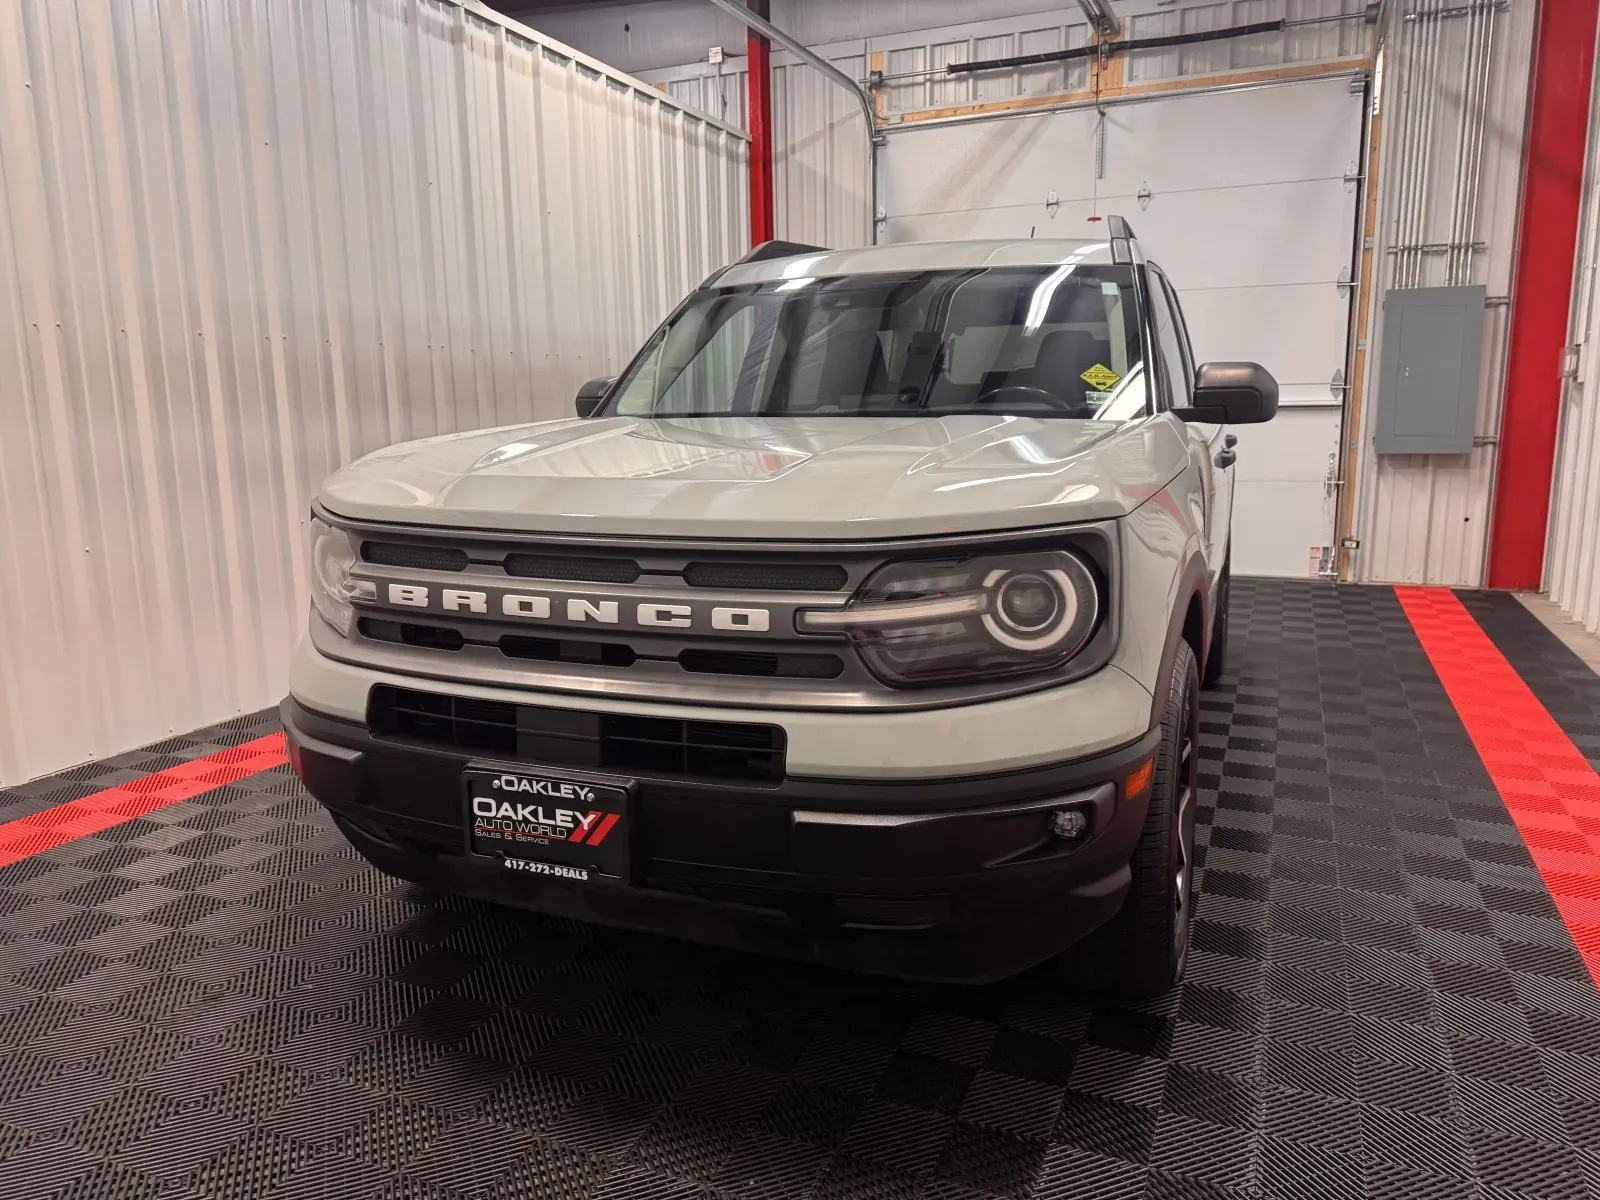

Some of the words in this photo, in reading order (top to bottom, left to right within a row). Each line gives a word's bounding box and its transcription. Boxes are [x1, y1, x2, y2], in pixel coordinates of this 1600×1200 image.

[388, 583, 770, 632] BRONCO
[501, 775, 590, 801] OAKLEY
[473, 797, 597, 831] OAKLEY
[475, 817, 513, 831] AUTO
[516, 821, 567, 839] WORLD
[504, 832, 513, 840] &
[504, 859, 588, 881] 417-272-DEALS
